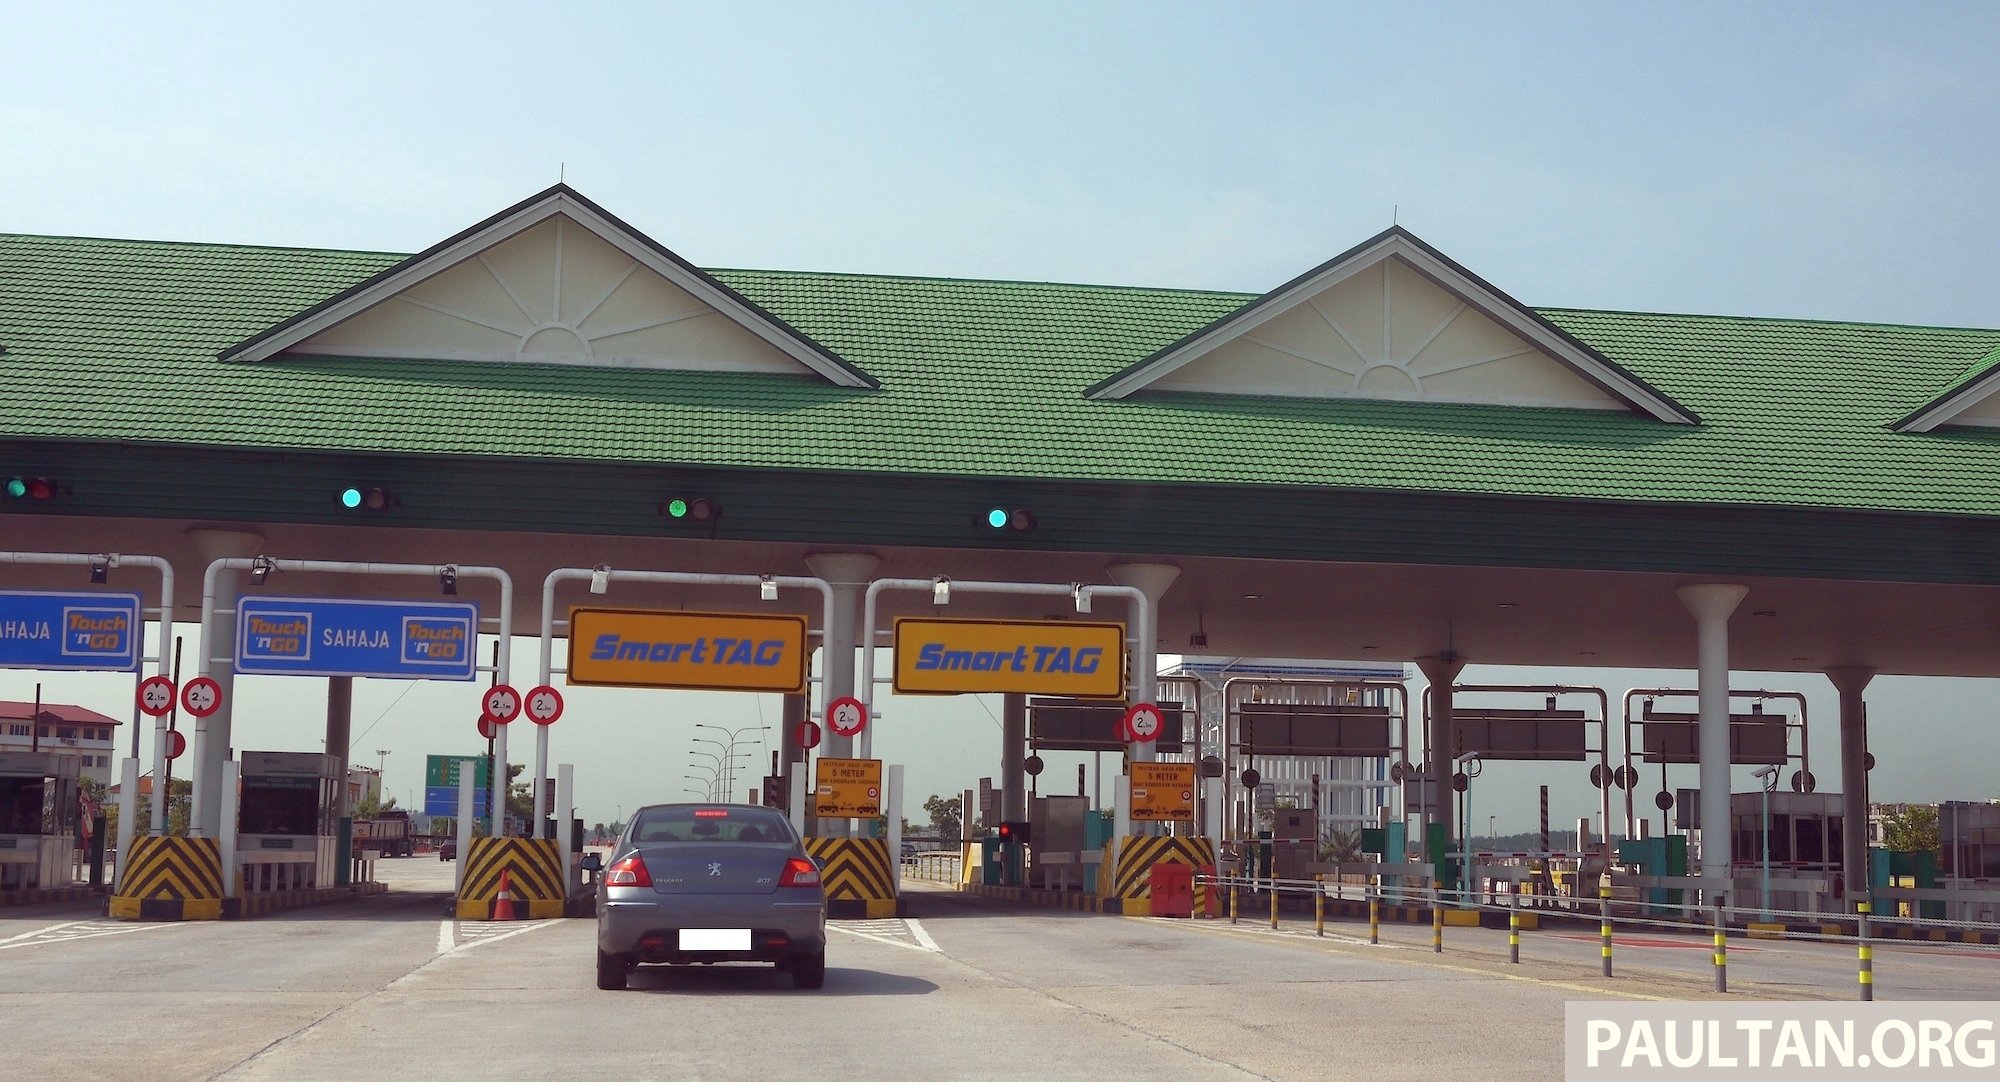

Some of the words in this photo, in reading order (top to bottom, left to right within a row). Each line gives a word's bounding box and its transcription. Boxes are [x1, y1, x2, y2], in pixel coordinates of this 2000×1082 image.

[0, 620, 50, 640] HAJA
[69, 613, 127, 631] Touch
[250, 617, 307, 635] Touch
[322, 627, 390, 649] SAHAJA
[408, 623, 465, 640] Touch
[832, 768, 837, 777] 5
[840, 769, 865, 777] METER
[1156, 773, 1178, 781] METER
